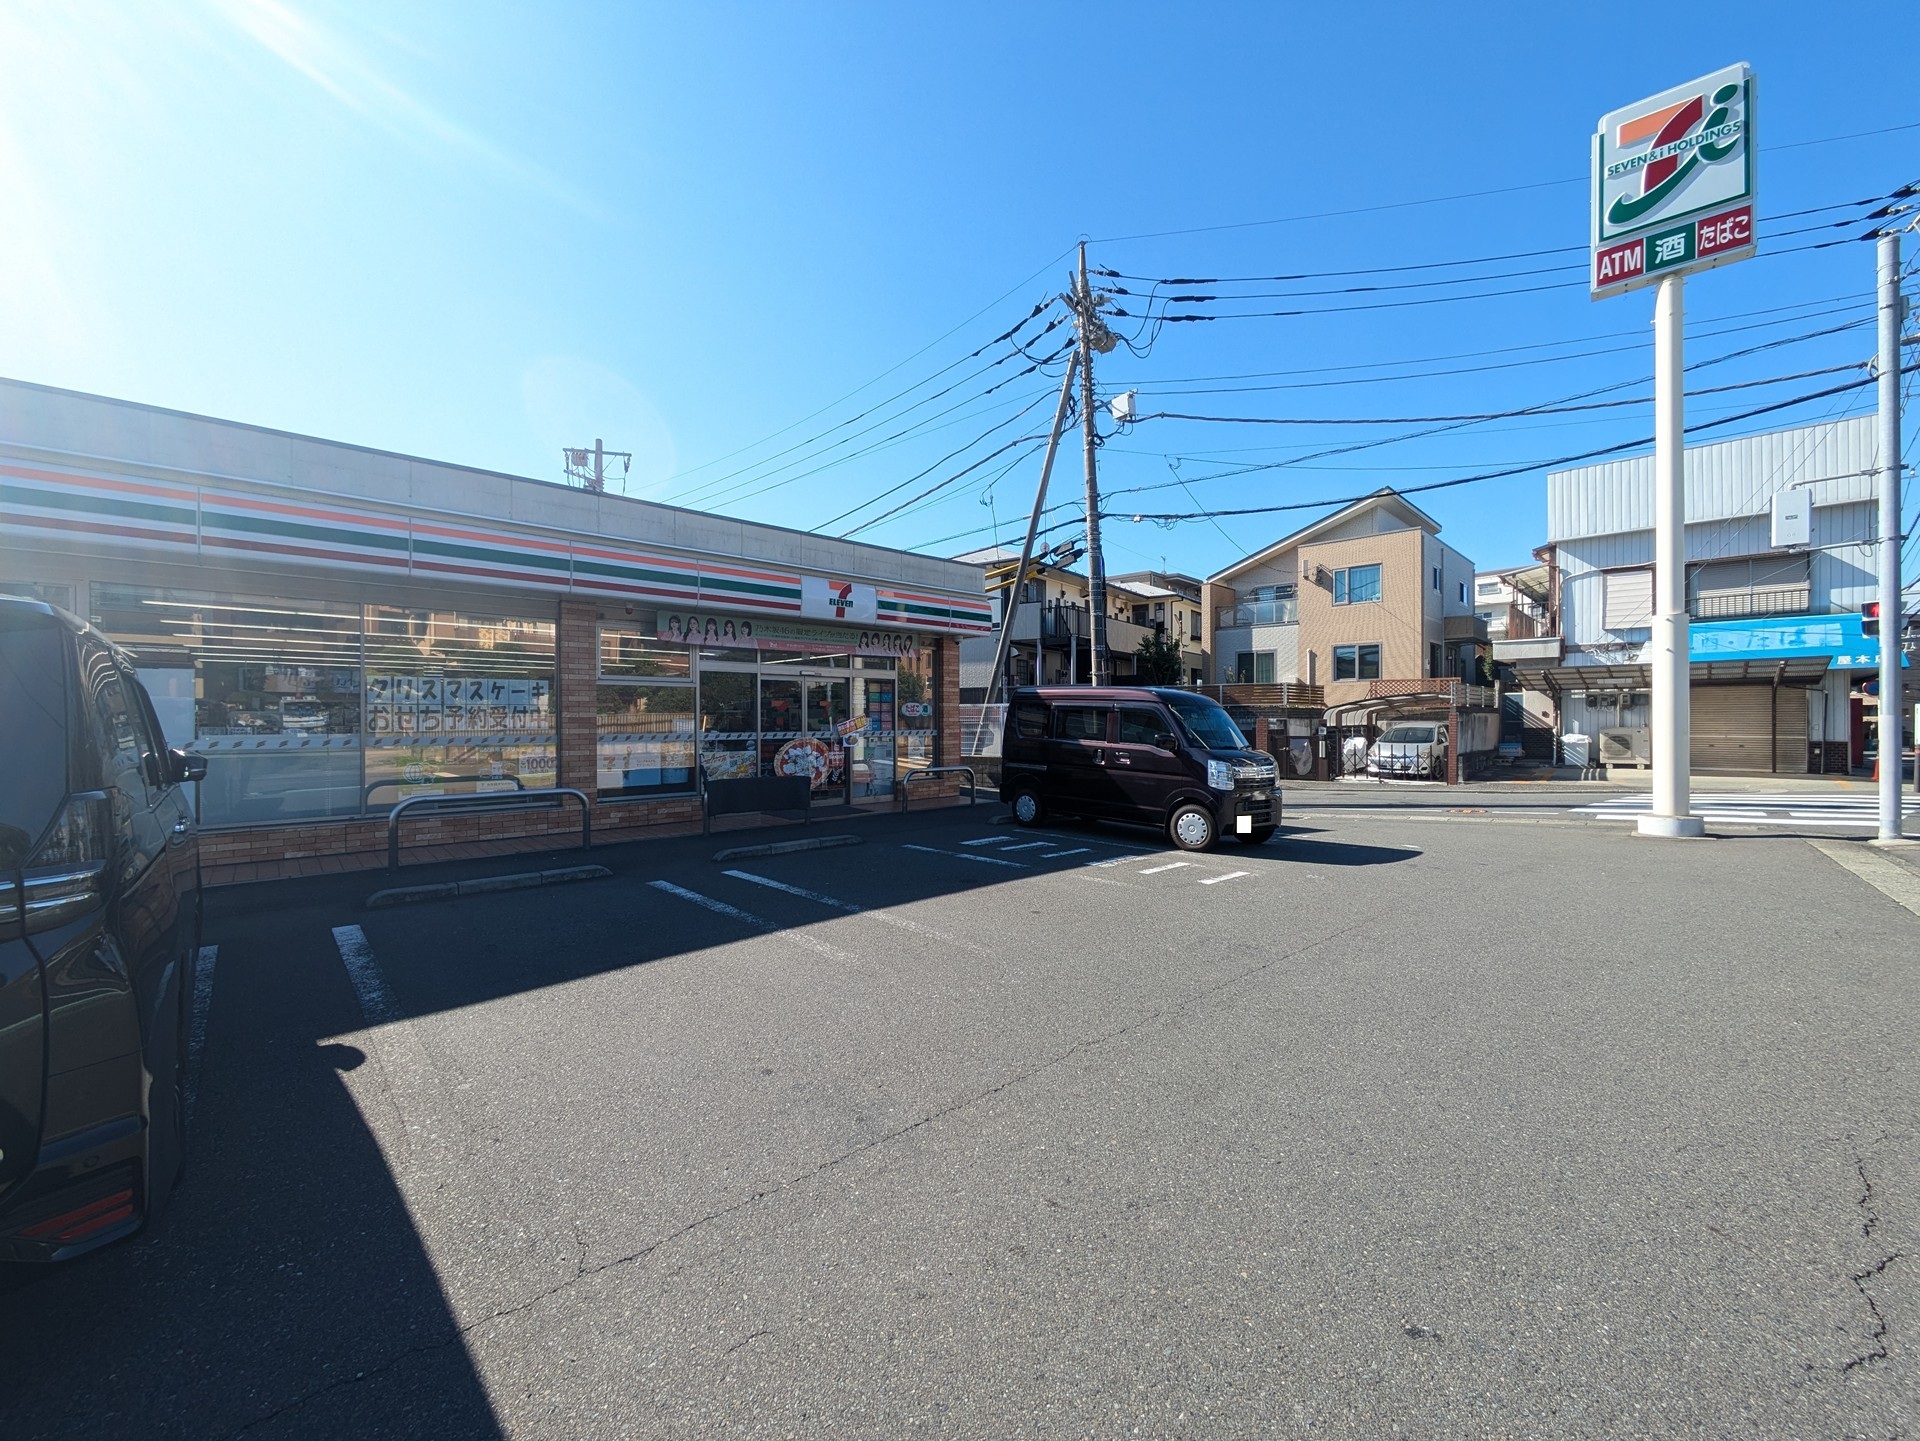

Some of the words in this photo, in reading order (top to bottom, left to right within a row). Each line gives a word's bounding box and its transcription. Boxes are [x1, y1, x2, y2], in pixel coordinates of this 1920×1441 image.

[1667, 120, 1741, 154] HOLDINGS
[1655, 231, 1686, 265] 酒
[1699, 215, 1750, 250] たばこ
[1599, 246, 1642, 281] ATM
[368, 676, 547, 701] クリスマスケーキ
[368, 704, 549, 732] おせち予約受付中
